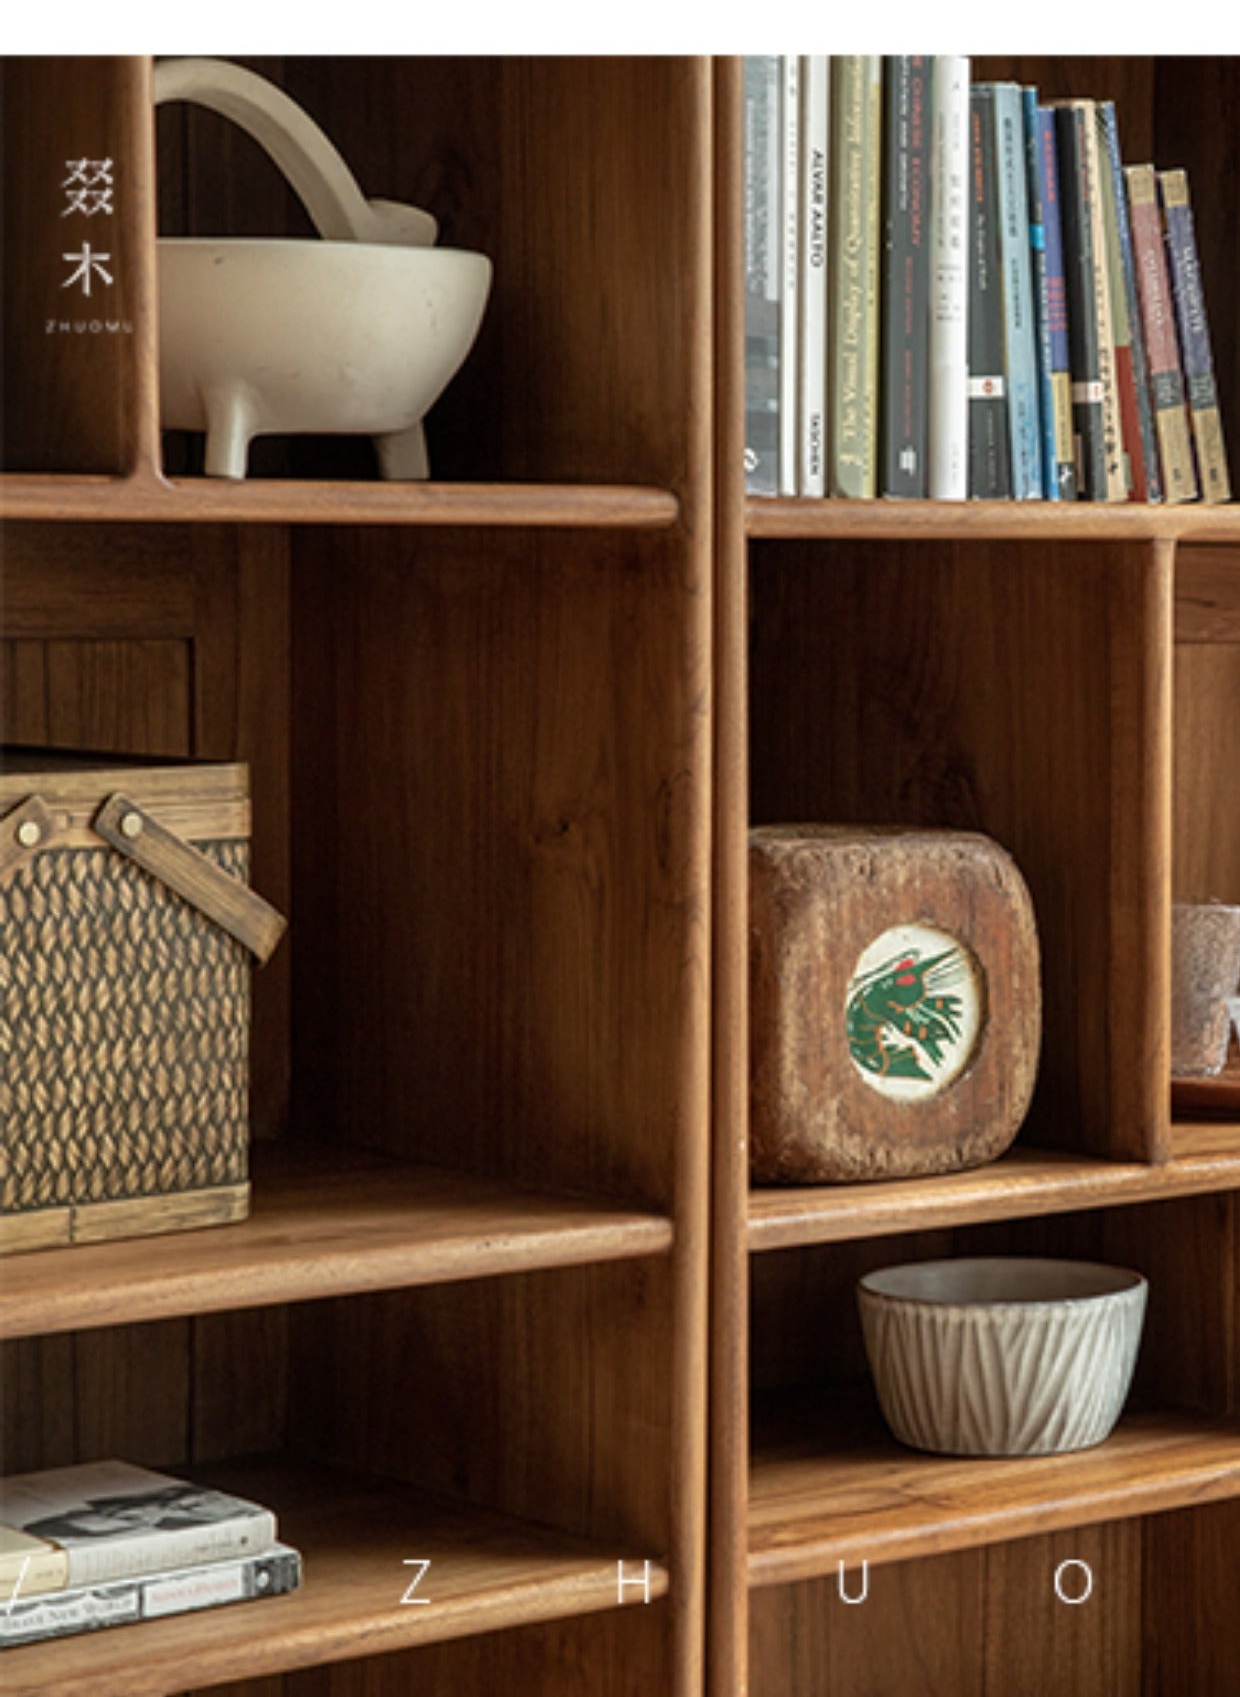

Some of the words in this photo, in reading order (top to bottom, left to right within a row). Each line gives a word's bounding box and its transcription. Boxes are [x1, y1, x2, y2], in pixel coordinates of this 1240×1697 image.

[811, 149, 826, 204] ALVAR
[911, 156, 925, 248] ECONOMY
[811, 208, 826, 268] AALTO
[842, 283, 863, 345] Display
[842, 350, 858, 403] Visual
[809, 412, 822, 475] TASCHEN
[842, 404, 857, 442] The
